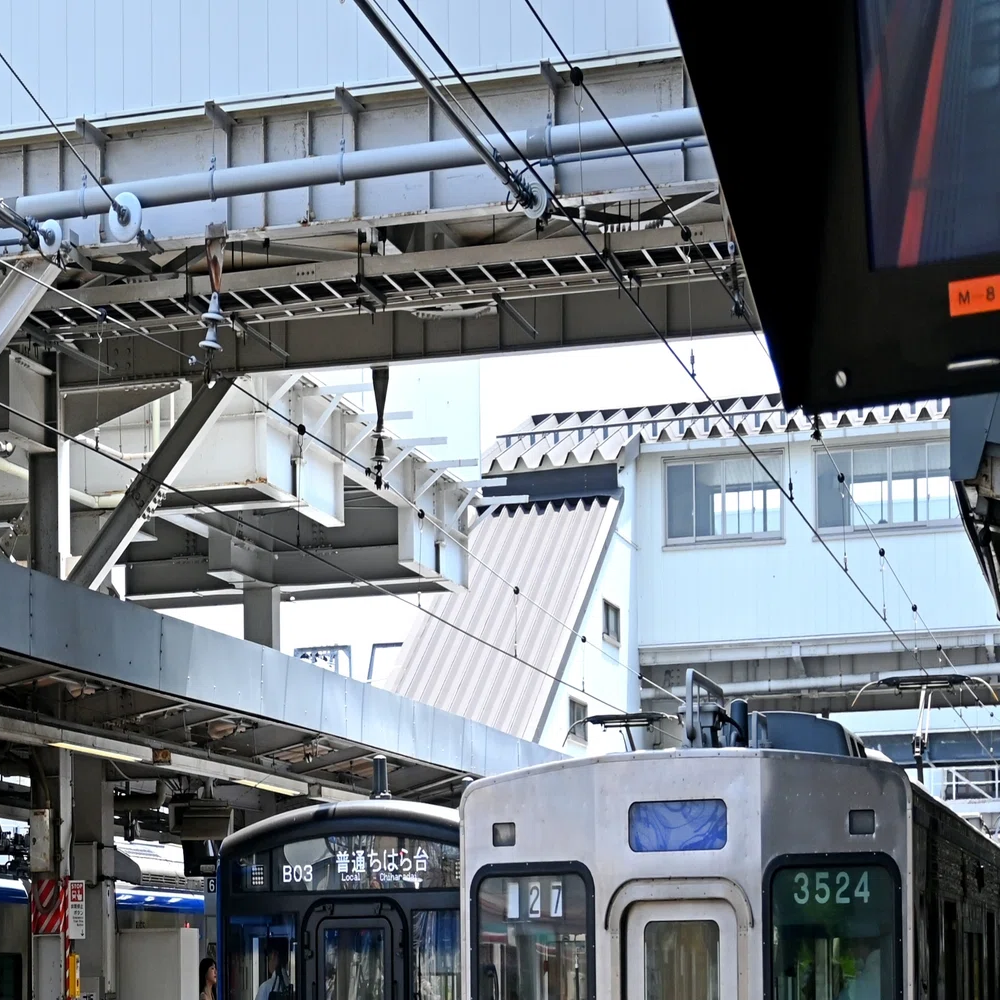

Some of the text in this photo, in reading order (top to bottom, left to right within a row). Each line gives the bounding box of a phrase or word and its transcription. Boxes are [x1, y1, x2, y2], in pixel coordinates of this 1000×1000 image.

[335, 846, 429, 873] 普通 ちはら台
[282, 864, 313, 883] B03
[341, 873, 361, 881] Local
[208, 879, 216, 892] 6
[793, 871, 870, 905] 3524
